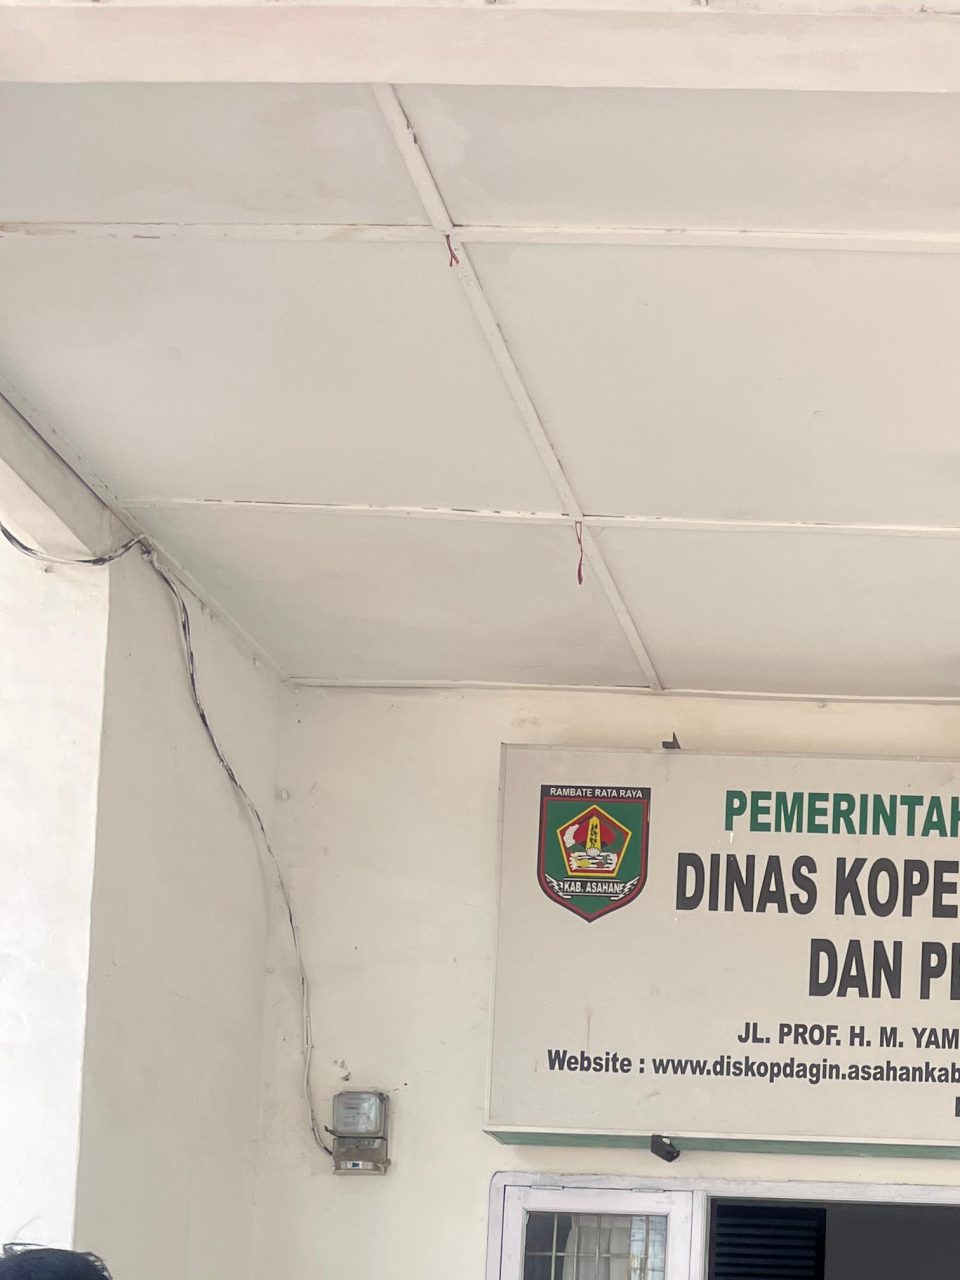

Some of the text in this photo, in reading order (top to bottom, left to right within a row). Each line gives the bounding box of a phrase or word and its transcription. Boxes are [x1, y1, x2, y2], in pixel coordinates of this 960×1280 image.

[550, 787, 643, 798] RAMBATE RATA RAYA
[564, 881, 620, 893] KAB. ASAHAN
[676, 853, 817, 915] DINAS
[809, 938, 902, 999] DAN
[738, 1022, 770, 1043] JL.
[779, 1023, 841, 1046] PROF.
[850, 1026, 871, 1047] H.
[880, 1027, 903, 1047] M.
[548, 1049, 632, 1073] Website
